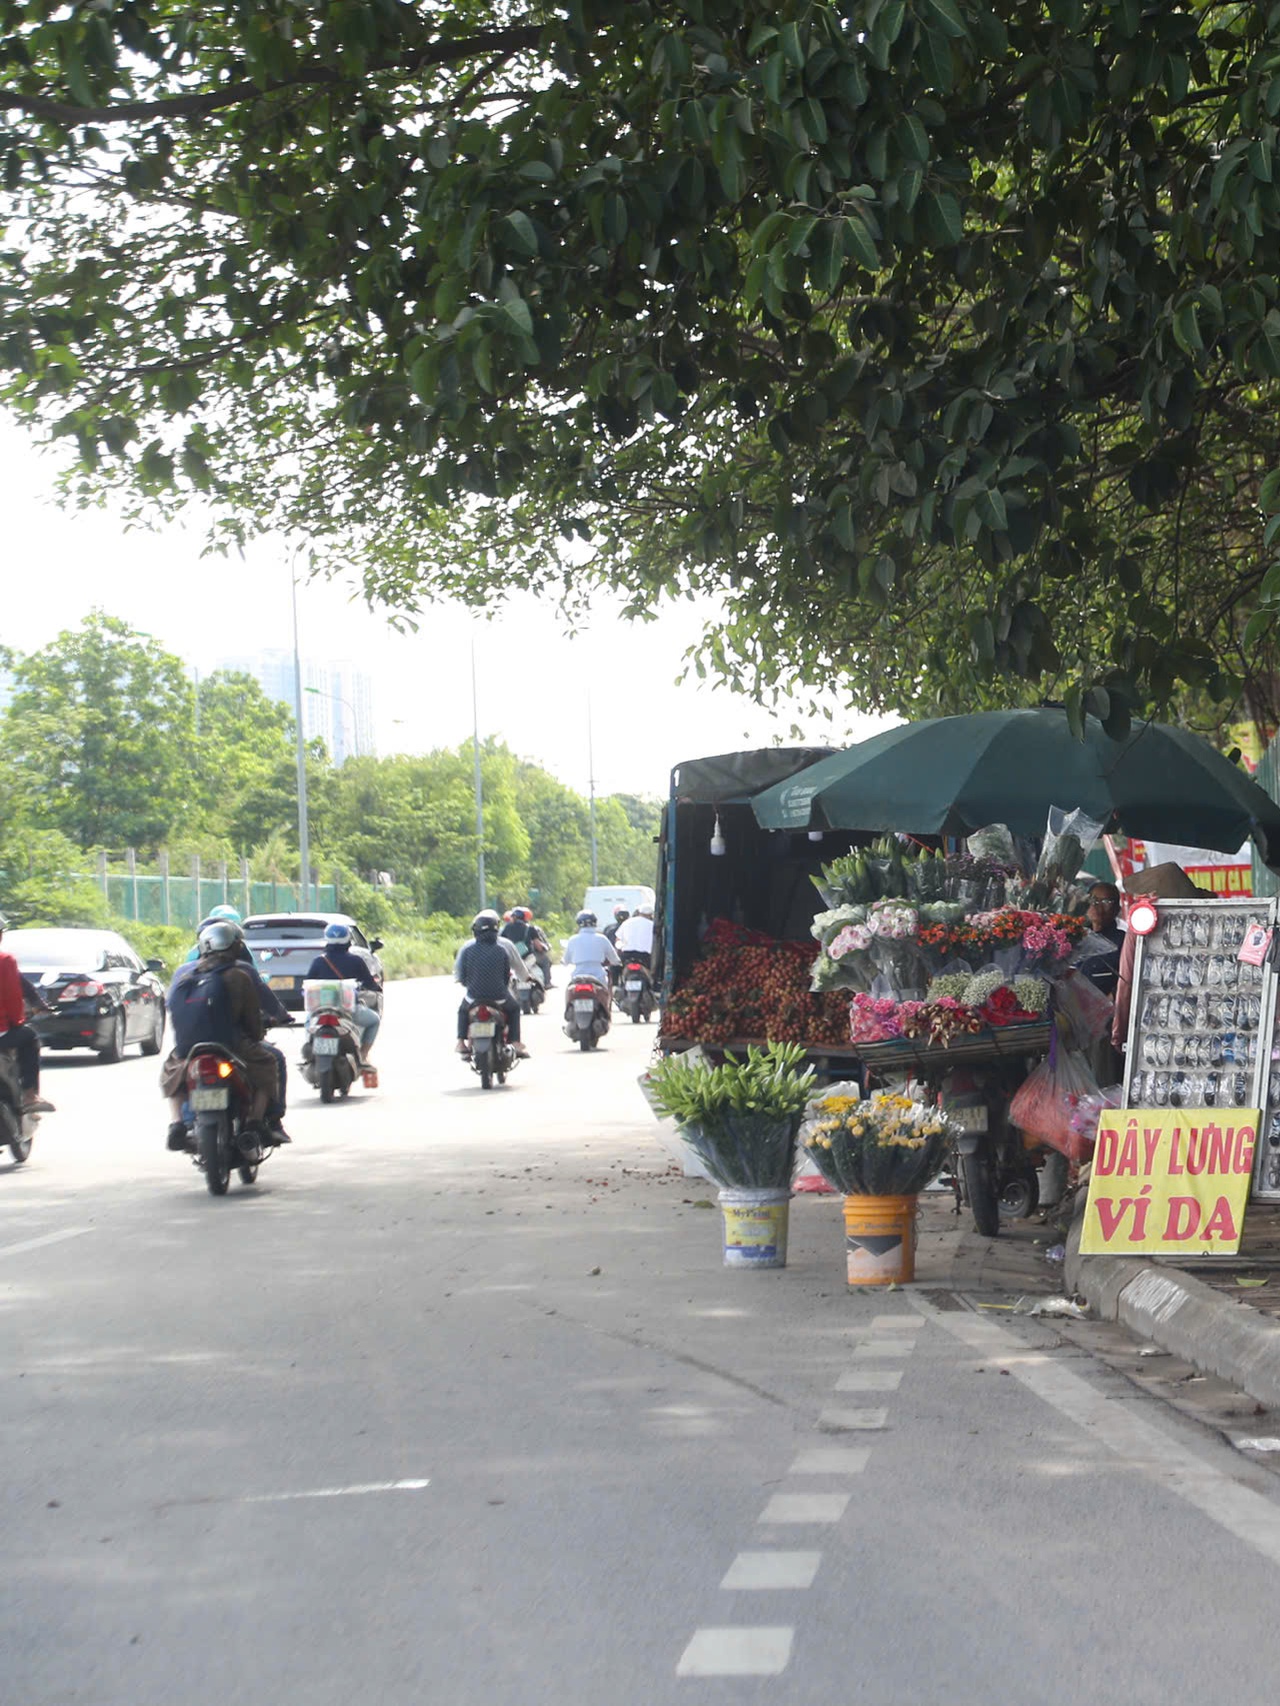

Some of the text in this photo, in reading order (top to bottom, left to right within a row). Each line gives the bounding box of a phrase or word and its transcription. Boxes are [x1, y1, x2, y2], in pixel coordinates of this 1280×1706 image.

[1095, 1118, 1256, 1177] DÂY LƯNG
[1094, 1184, 1238, 1243] VÍ DA
